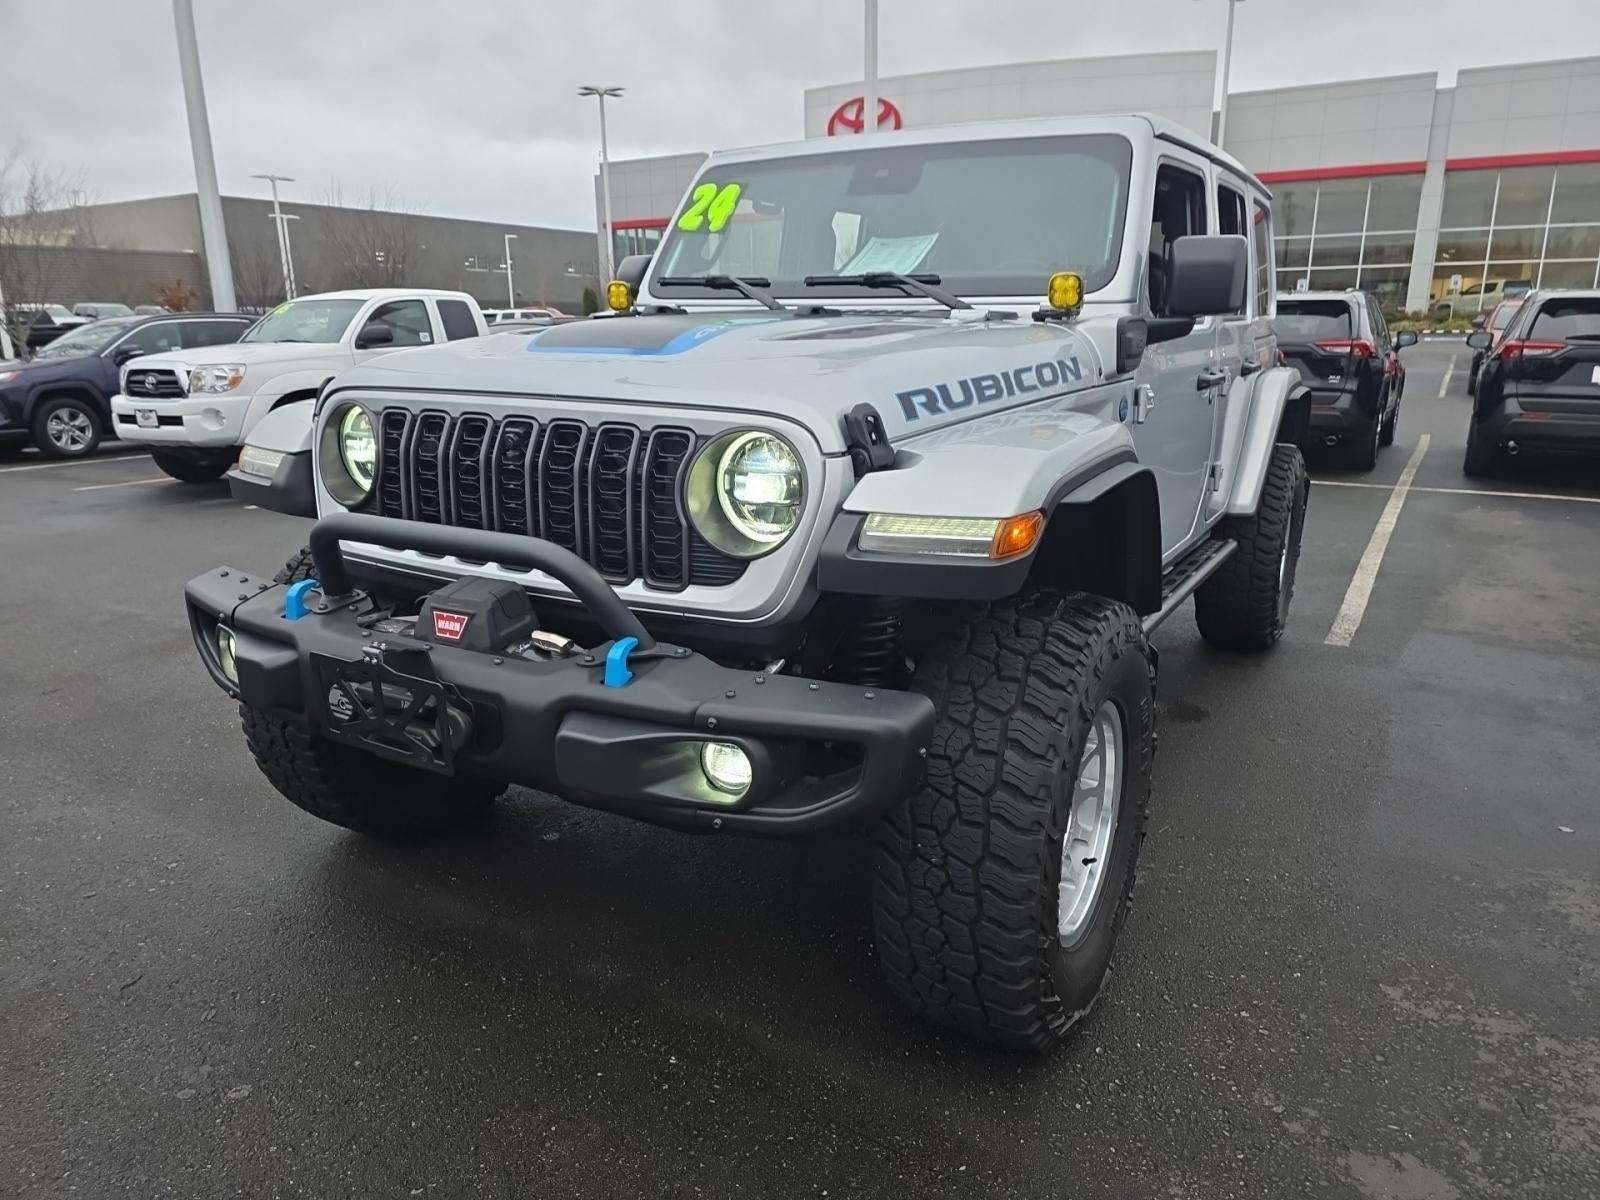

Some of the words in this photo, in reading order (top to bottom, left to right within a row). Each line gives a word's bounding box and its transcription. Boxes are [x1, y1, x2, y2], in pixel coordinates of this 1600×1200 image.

[678, 183, 741, 232] 24
[895, 356, 1083, 423] RUBICON
[437, 619, 461, 632] WARN
